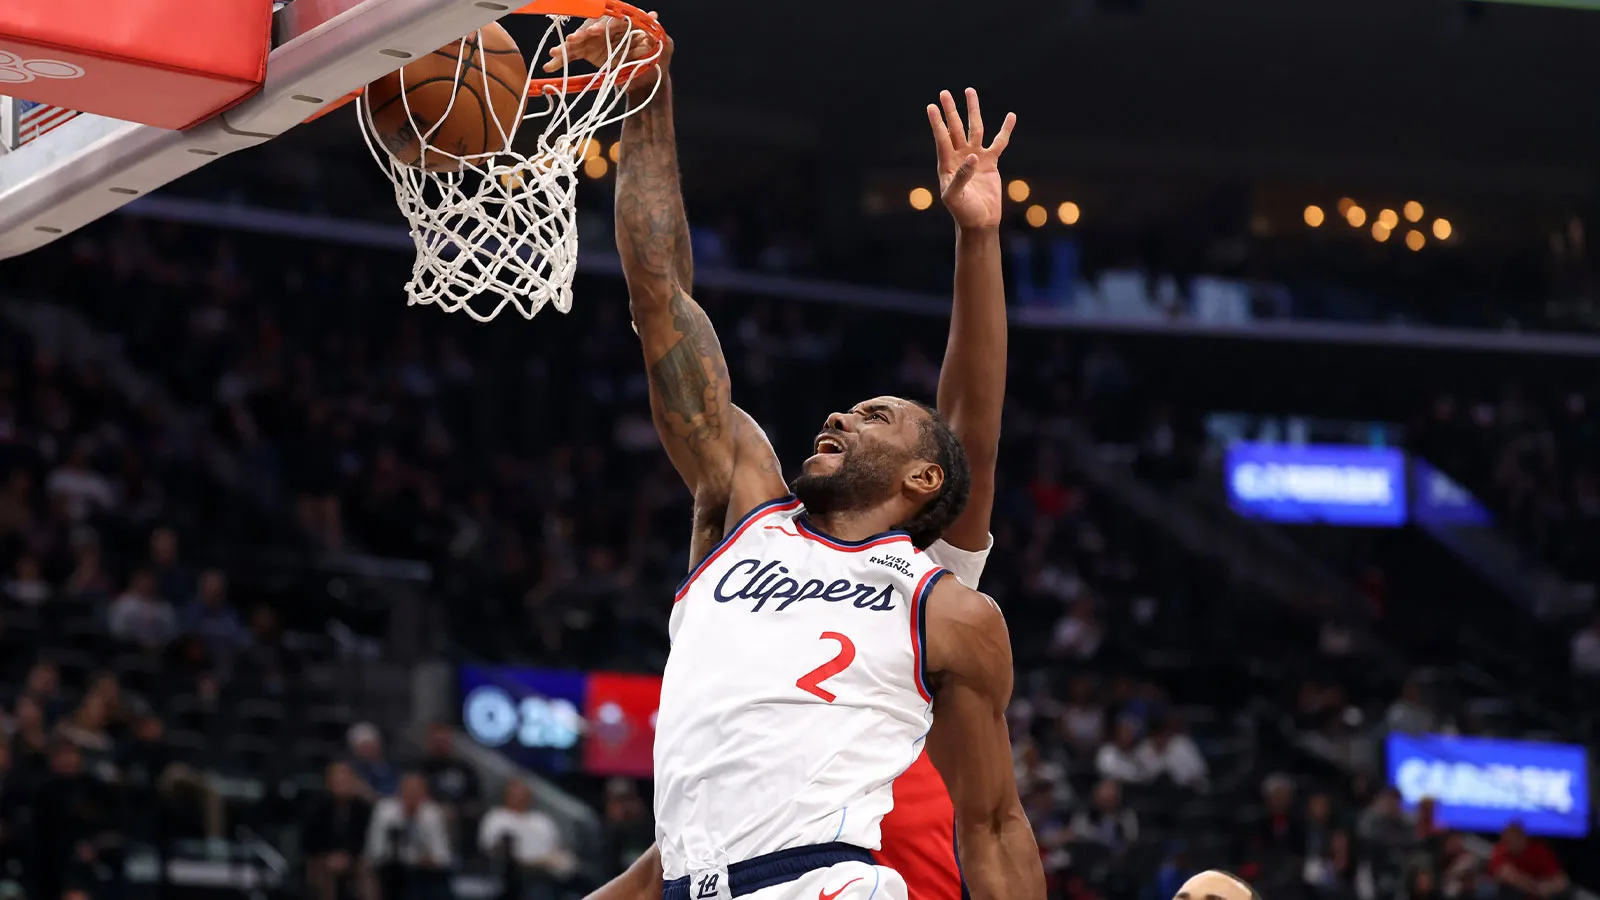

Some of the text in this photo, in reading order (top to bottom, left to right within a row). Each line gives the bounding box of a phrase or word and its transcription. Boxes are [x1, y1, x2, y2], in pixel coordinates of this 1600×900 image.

[869, 556, 914, 578] RWANDA
[885, 554, 911, 568] VISIT
[713, 559, 896, 612] Clippers
[795, 631, 856, 703] 2
